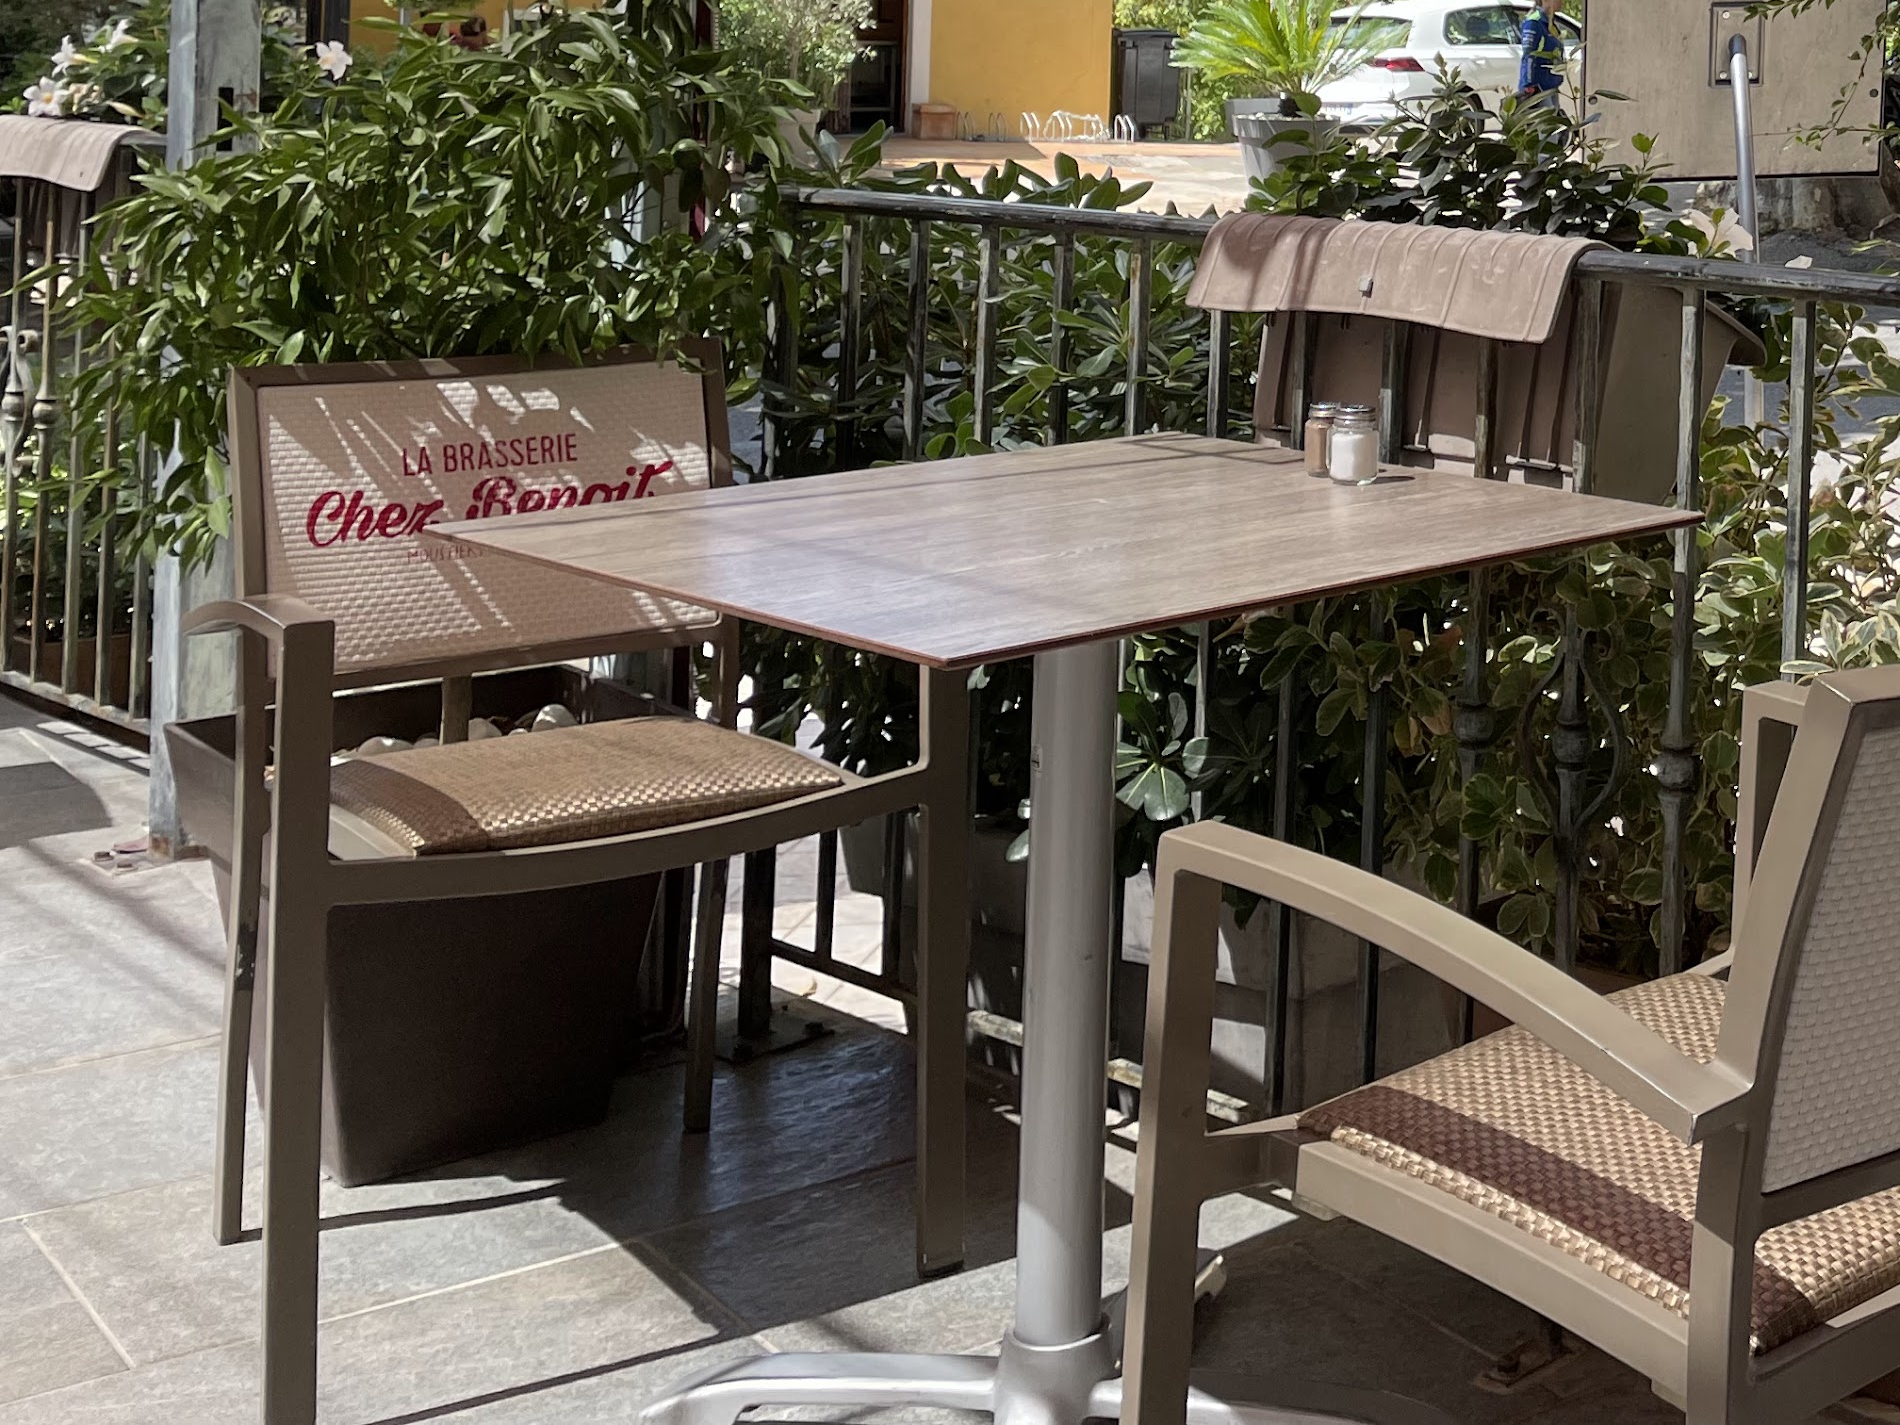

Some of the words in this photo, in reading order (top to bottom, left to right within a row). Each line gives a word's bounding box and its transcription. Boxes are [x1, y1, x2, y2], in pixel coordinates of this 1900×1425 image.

[403, 446, 433, 476] LA
[443, 433, 578, 473] BRASSERIE
[307, 489, 445, 547] Chez
